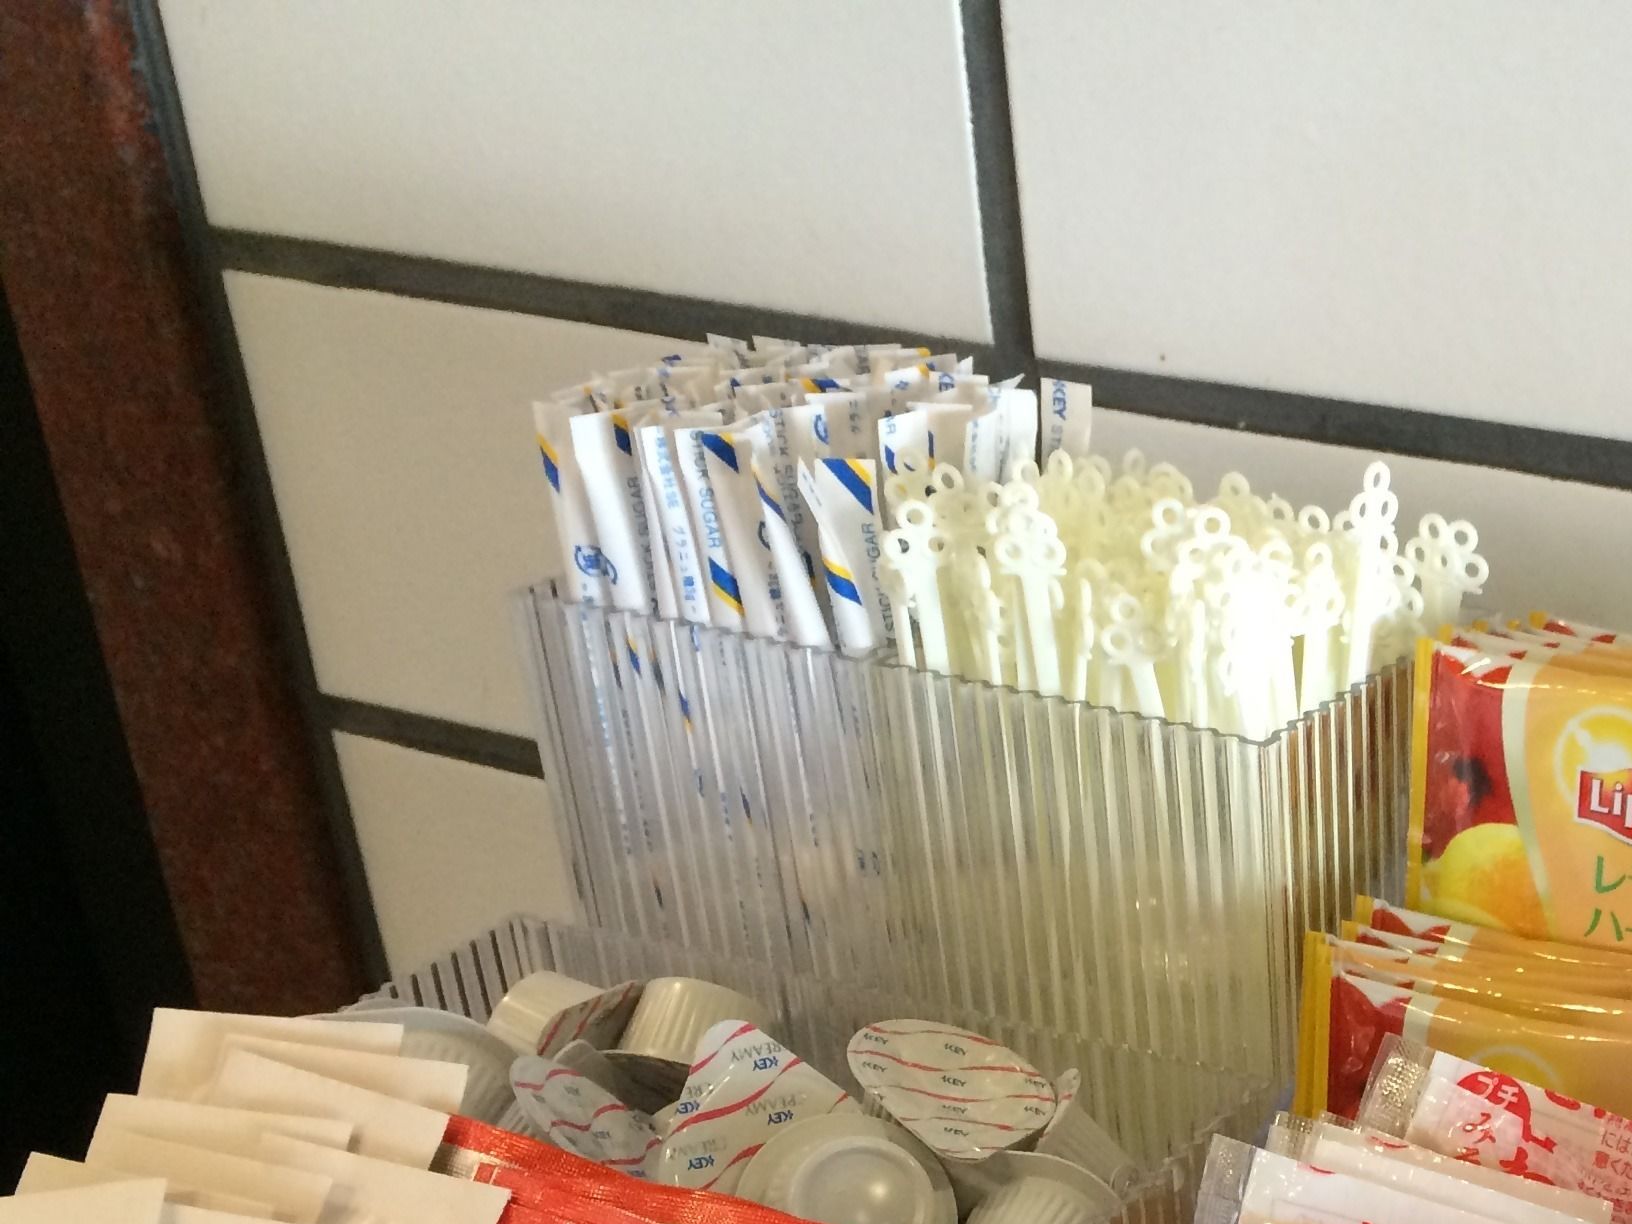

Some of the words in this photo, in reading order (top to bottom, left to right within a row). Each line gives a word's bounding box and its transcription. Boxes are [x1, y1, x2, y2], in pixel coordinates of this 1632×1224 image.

[699, 487, 722, 549] SUGAR
[752, 1055, 779, 1071] KEY
[941, 1074, 968, 1088] KEY
[1472, 1073, 1522, 1108] プチ
[767, 1109, 794, 1126] KEY
[688, 1155, 715, 1171] KEY
